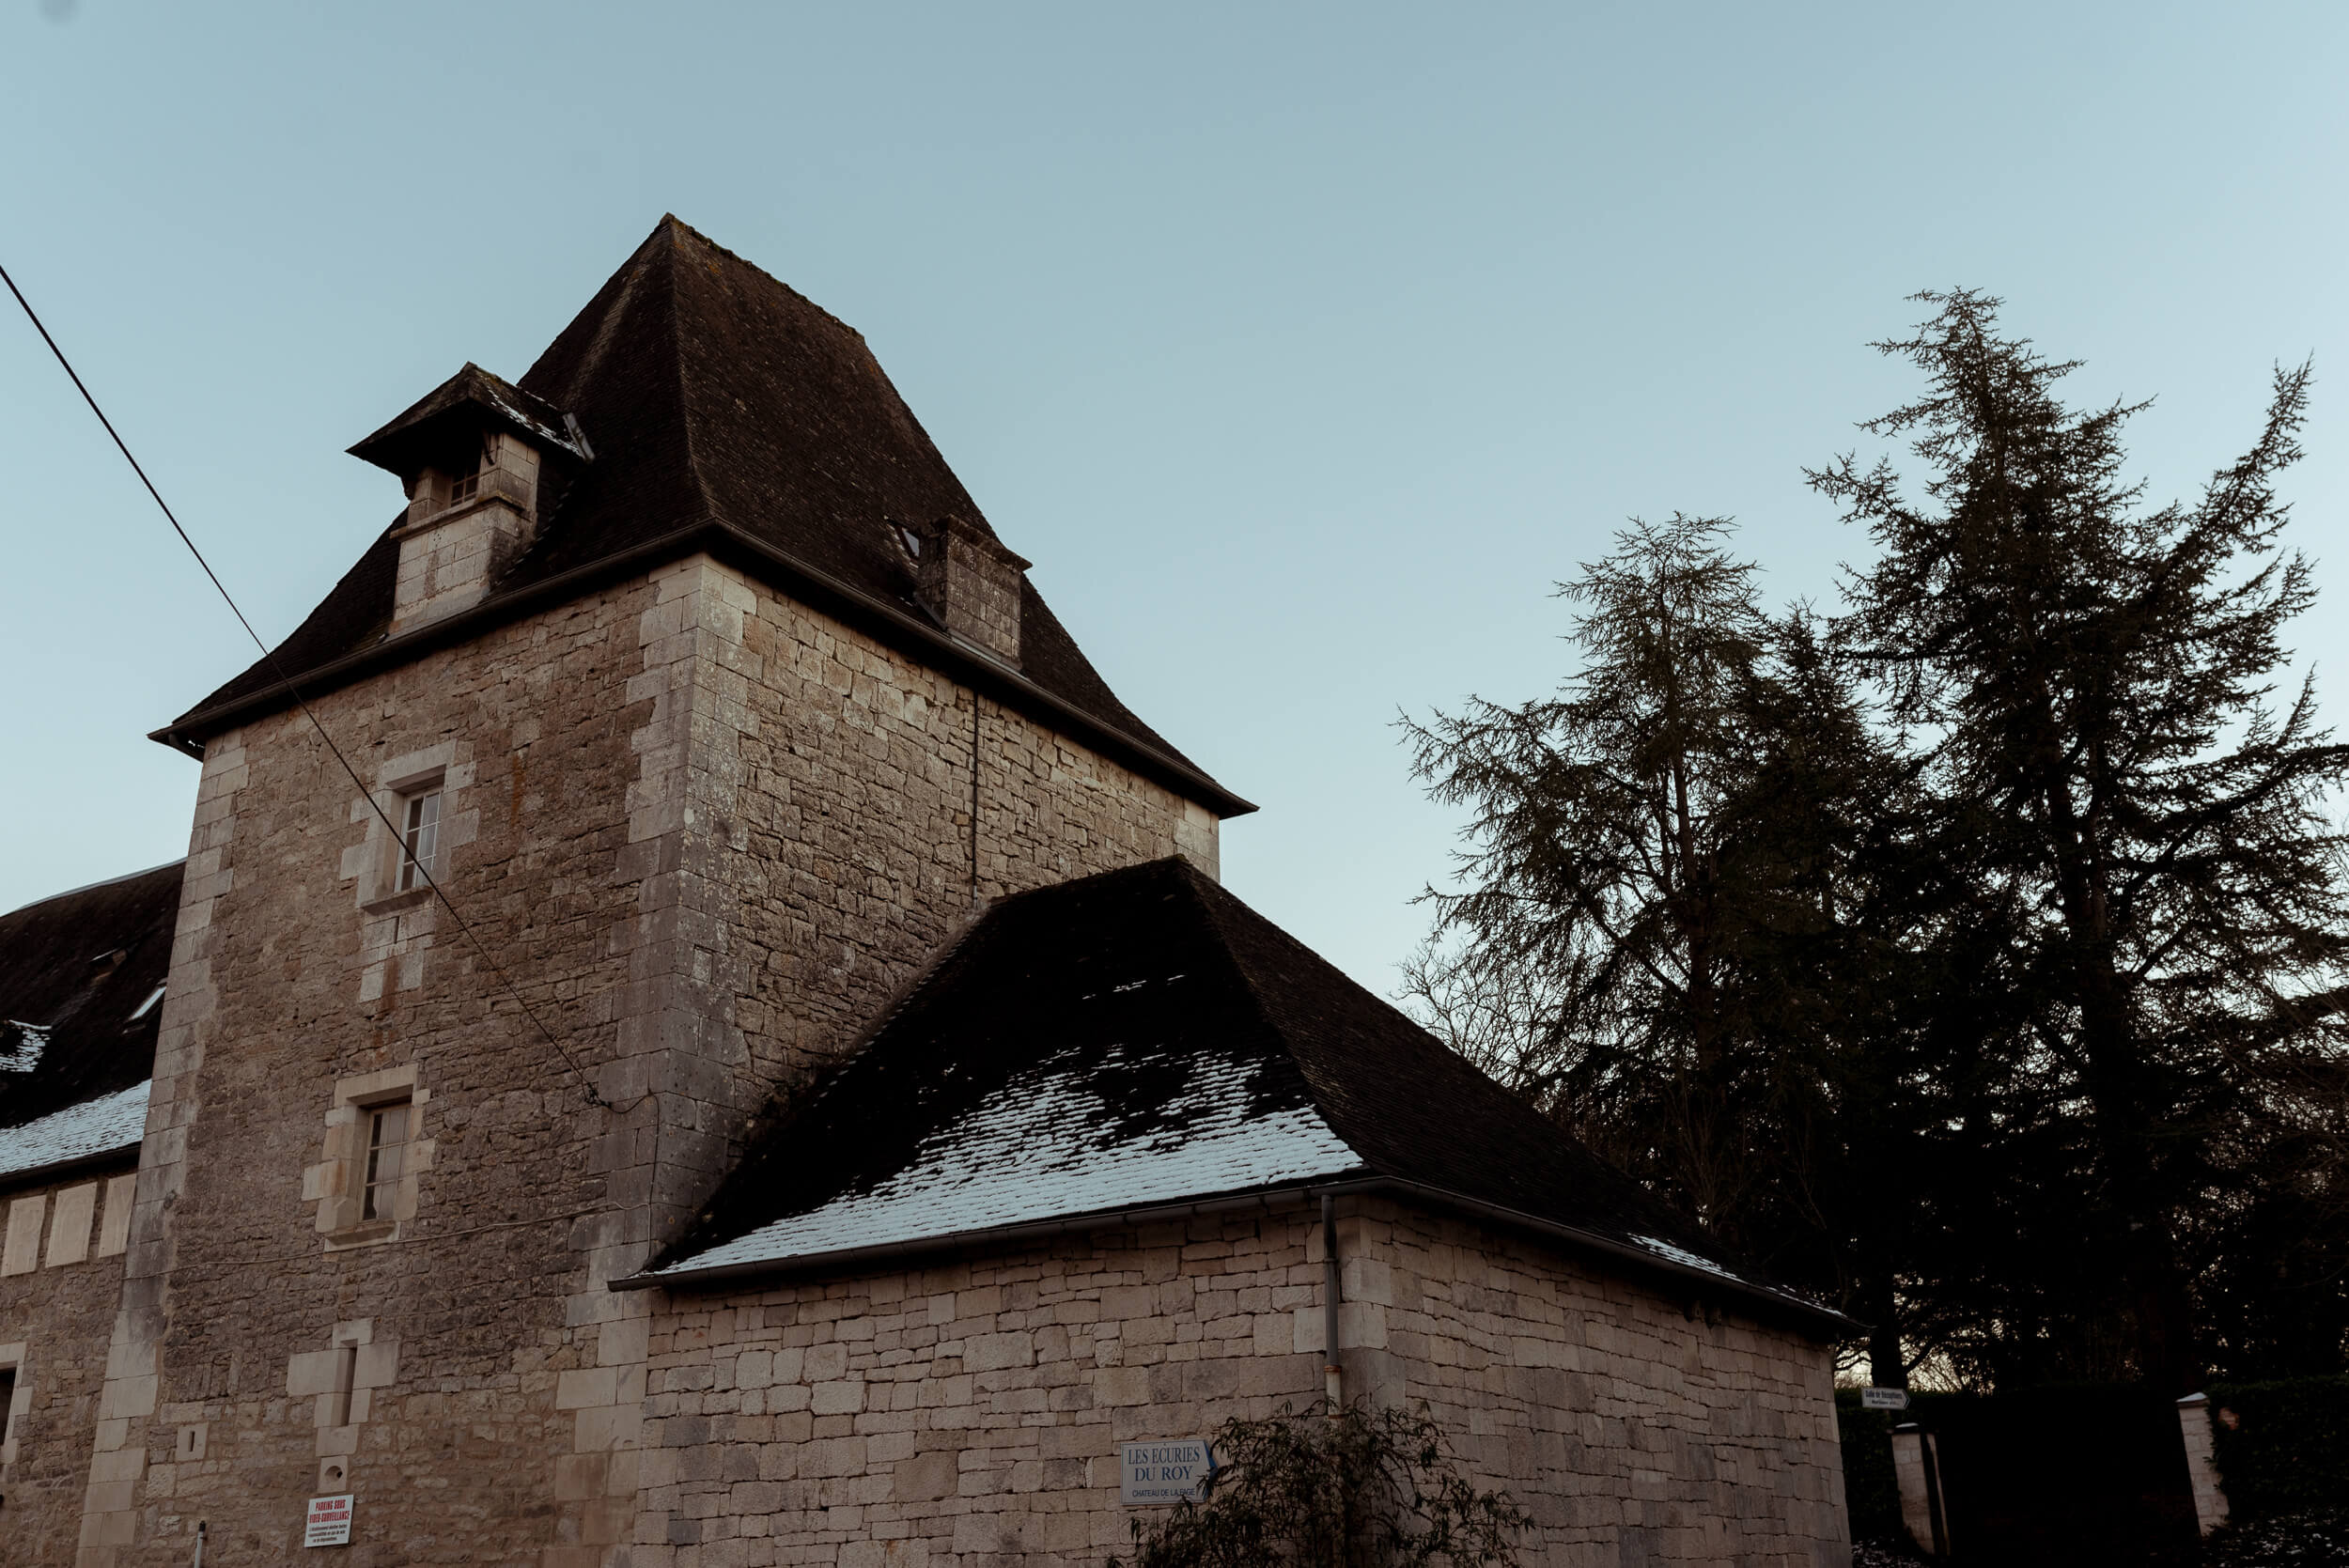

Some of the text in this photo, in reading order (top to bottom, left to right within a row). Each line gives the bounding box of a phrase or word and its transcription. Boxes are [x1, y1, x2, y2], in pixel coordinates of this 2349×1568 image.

[1128, 1447, 1200, 1465] LES ECURIES
[1135, 1466, 1193, 1482] DU ROY
[1132, 1489, 1159, 1498] CHATEAU
[1160, 1488, 1169, 1497] DE
[1171, 1488, 1179, 1497] LA
[316, 1499, 347, 1512] PARKING SOUS
